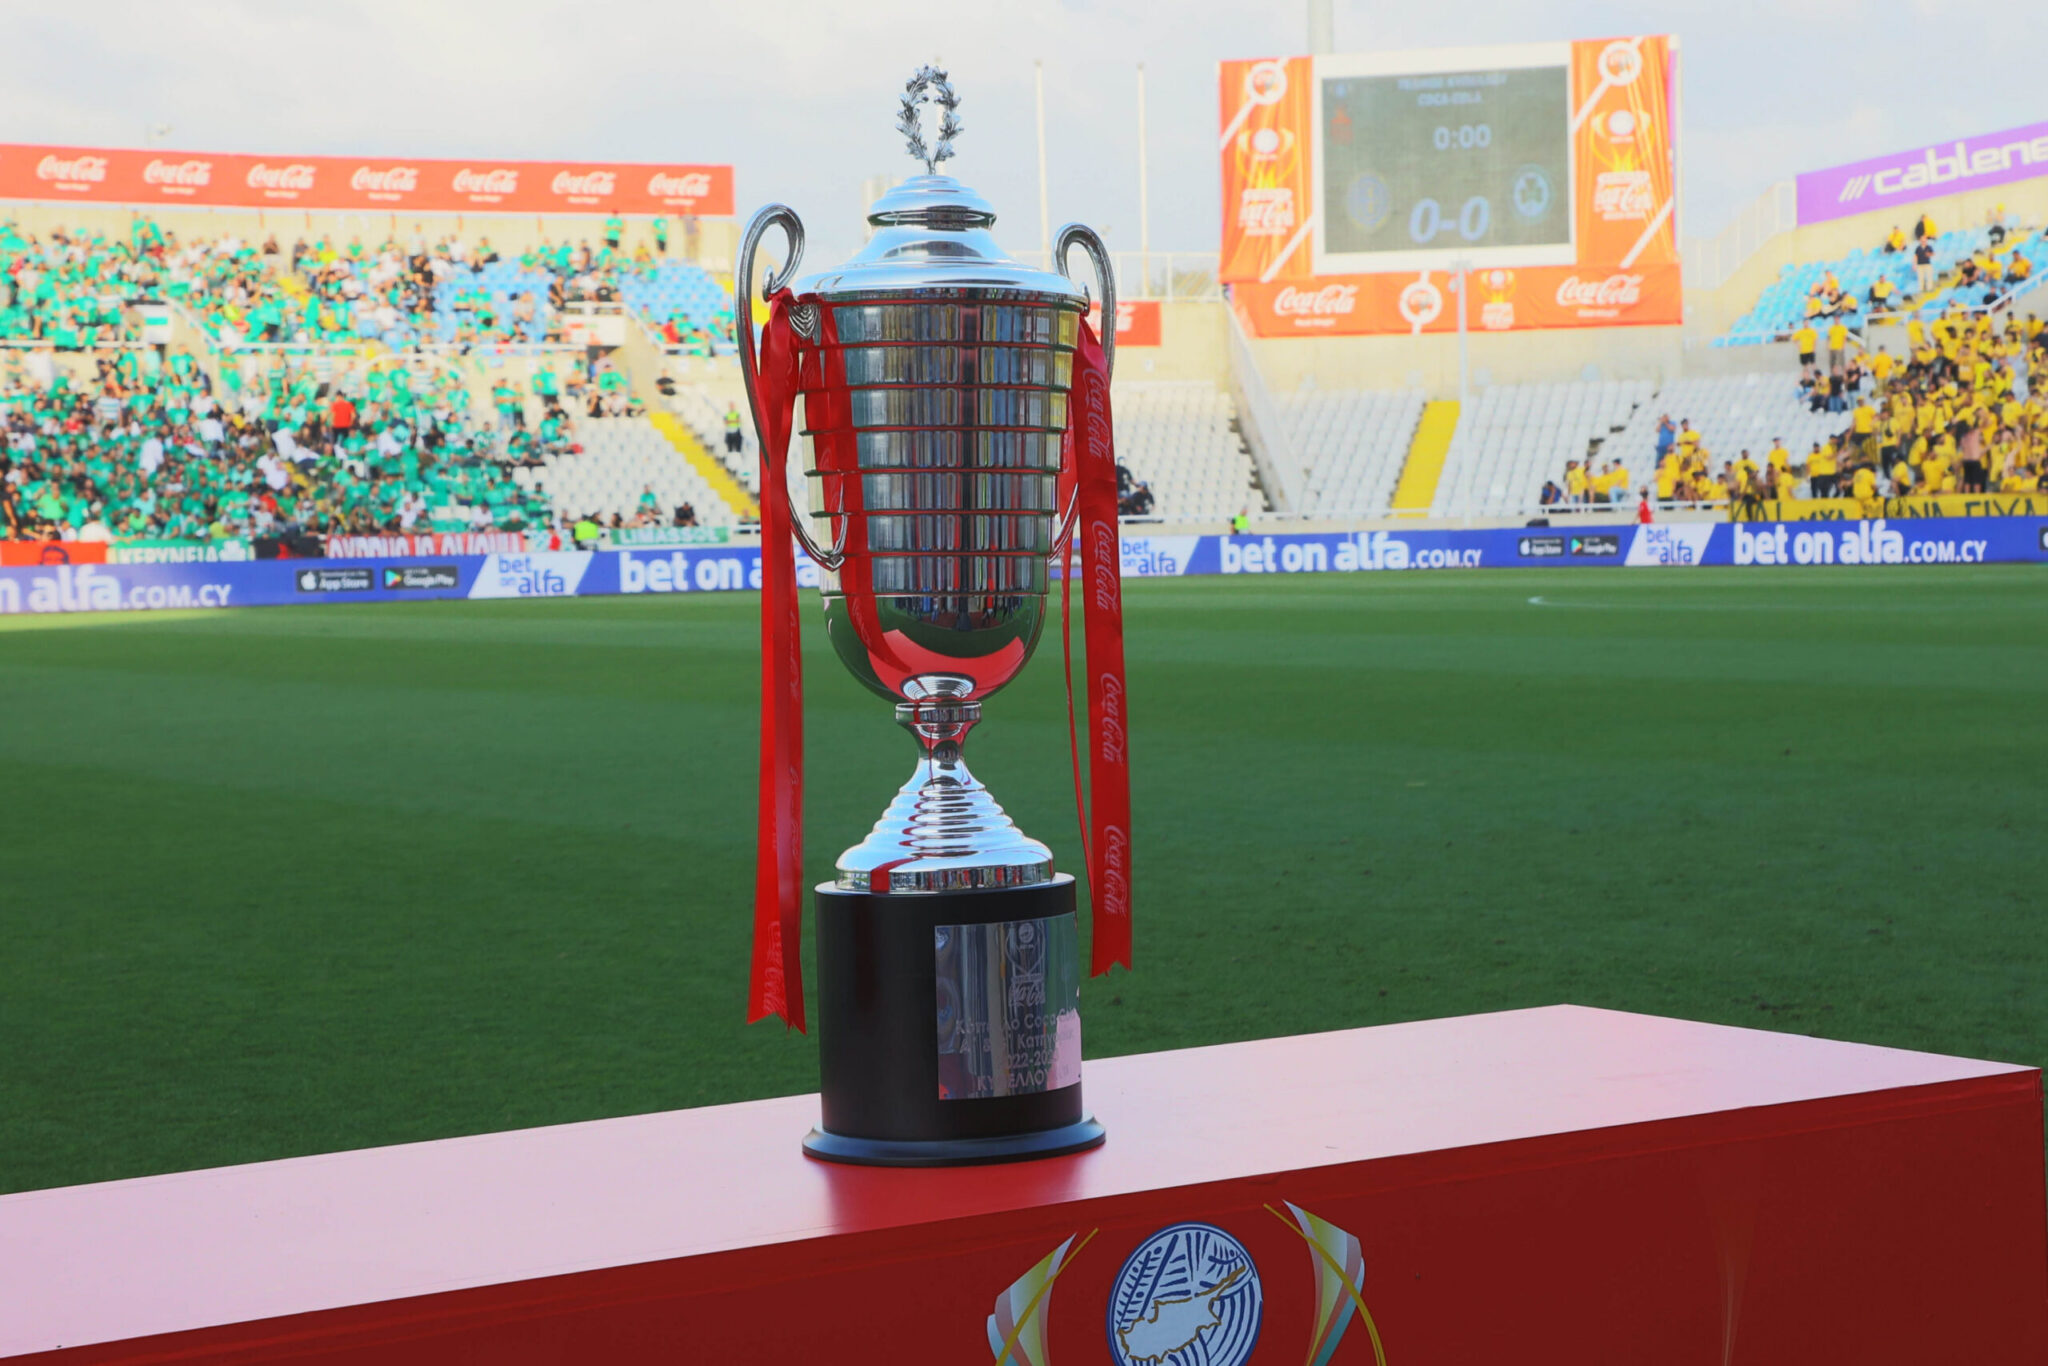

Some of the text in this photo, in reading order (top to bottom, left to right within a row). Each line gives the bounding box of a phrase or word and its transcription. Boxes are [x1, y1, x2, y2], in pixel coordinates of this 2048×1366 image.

[1433, 124, 1492, 151] 0:00
[1409, 196, 1491, 243] 0-0
[1121, 538, 1150, 555] bet
[1645, 528, 1670, 543] bet
[1733, 522, 1789, 565] bet
[1793, 530, 1834, 564] on
[498, 555, 532, 574] bet
[1138, 551, 1177, 574] alfa
[1219, 535, 1277, 574] bet
[1281, 542, 1329, 572] on
[1658, 540, 1693, 564] alfa
[518, 568, 566, 594] alfa
[619, 552, 689, 594] bet
[694, 557, 744, 590] on
